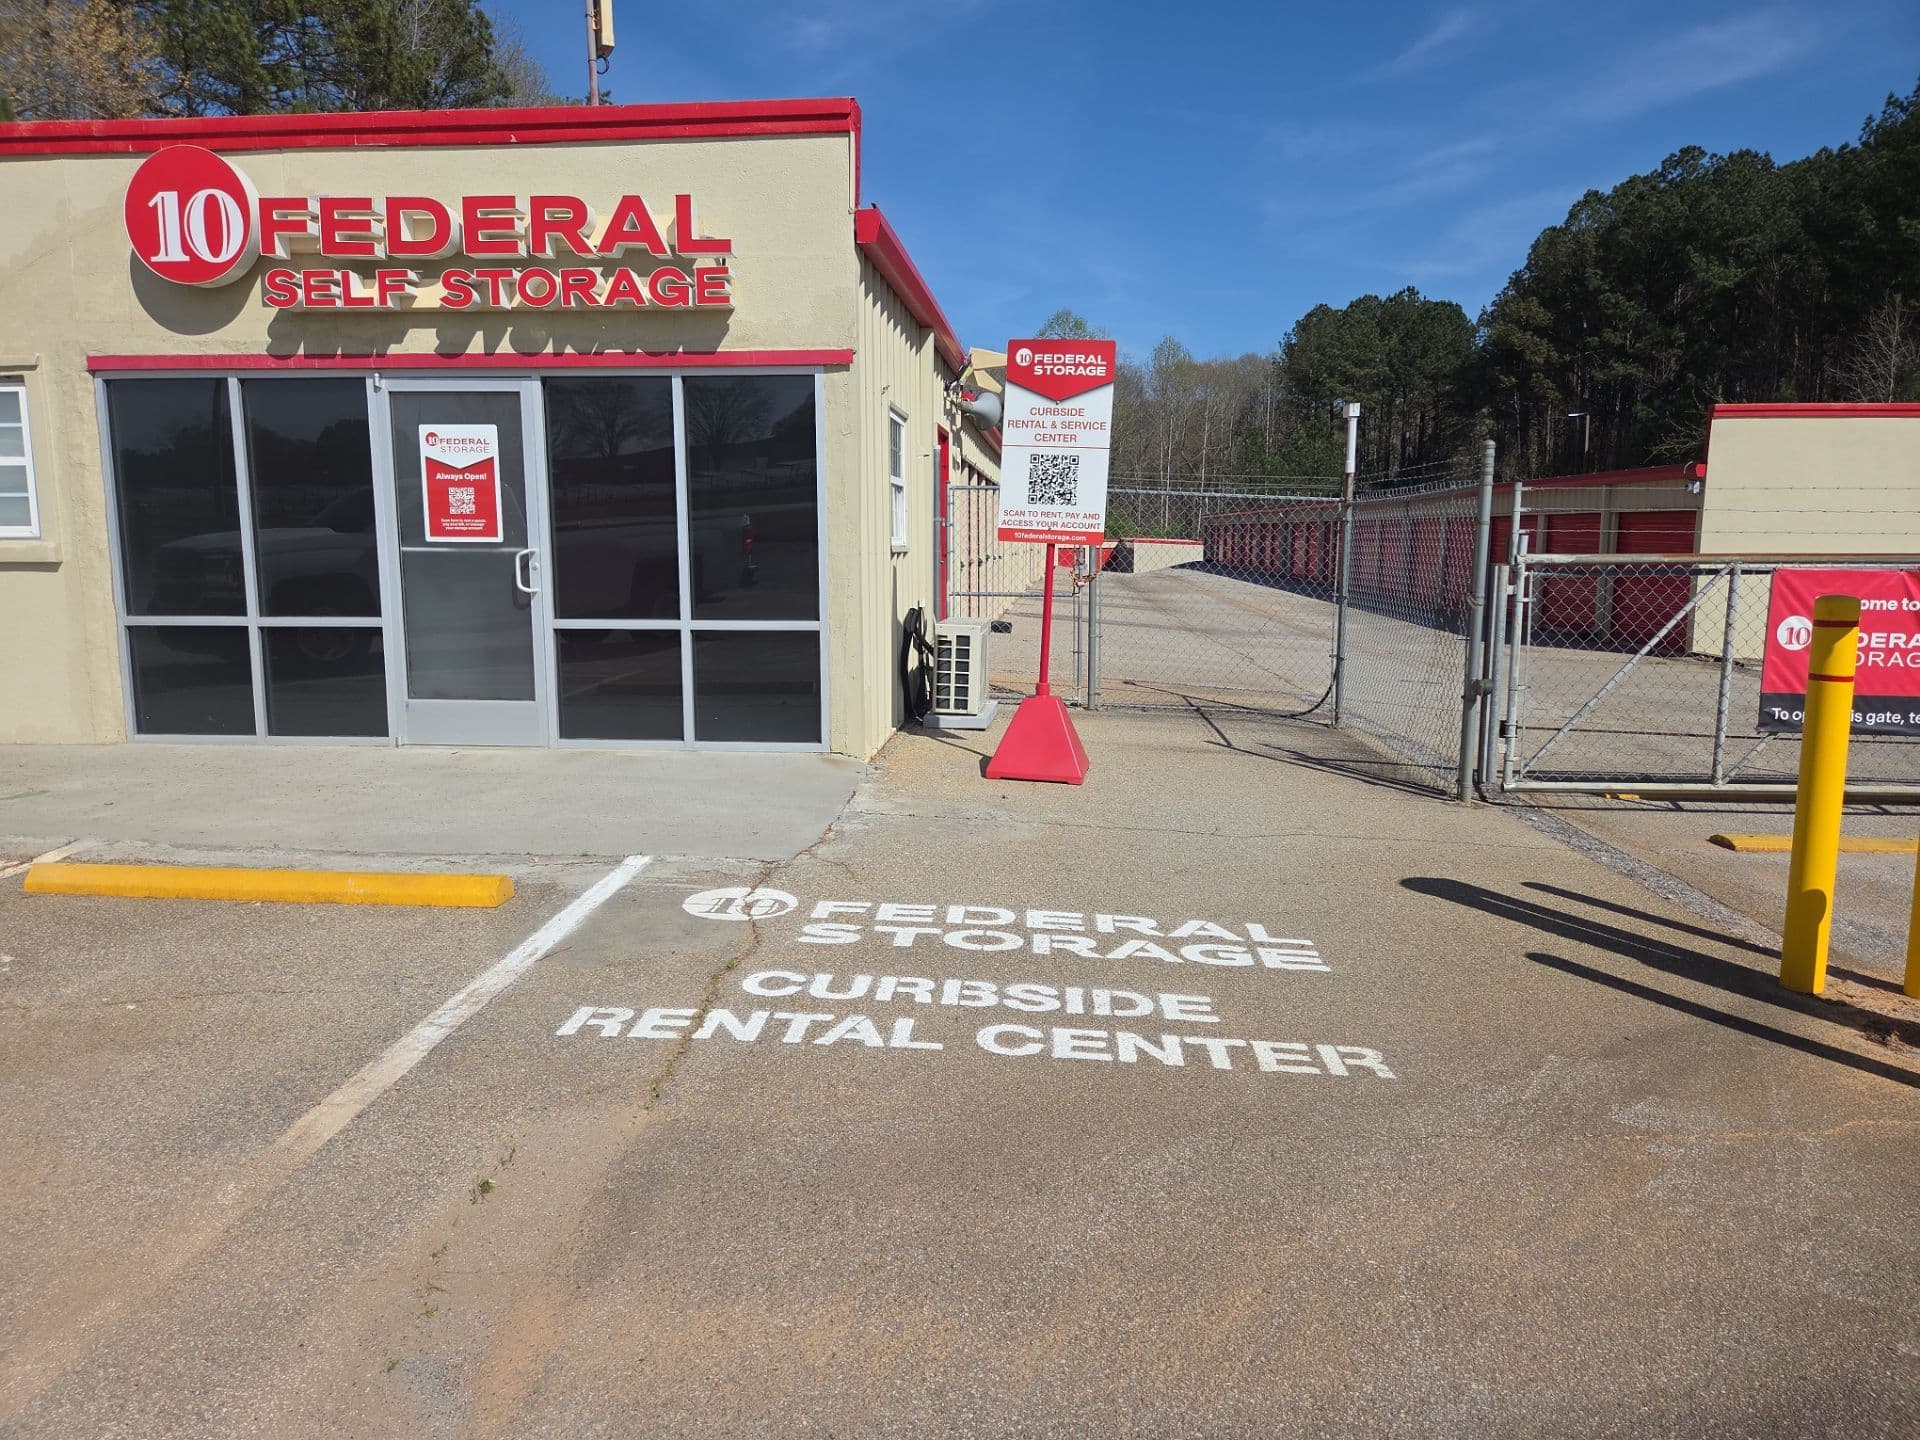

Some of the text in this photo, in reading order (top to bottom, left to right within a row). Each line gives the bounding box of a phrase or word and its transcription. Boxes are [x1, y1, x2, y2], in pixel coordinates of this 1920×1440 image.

[148, 188, 734, 264] 10 FEDERAL
[264, 266, 732, 309] SELF STORAGE
[1034, 353, 1107, 365] FEDERAL
[1033, 365, 1107, 377] STORAGE
[1029, 407, 1085, 417] CURBSIDE
[1007, 419, 1107, 431] RENTAL & SERVICE
[439, 438, 490, 446] FEDERAL
[1034, 433, 1077, 443] CENTER
[440, 445, 490, 454] STORAGE
[436, 472, 463, 481] Always
[1003, 509, 1026, 517] SCAN
[1028, 510, 1038, 518] TO
[1065, 512, 1080, 520] PAY
[1082, 513, 1100, 521] AND
[1001, 519, 1101, 530] ACCESS YOUR ACCOUNT
[1901, 597, 1920, 611] to
[1857, 632, 1920, 649] DERA
[1772, 707, 1789, 720] To
[1850, 709, 1863, 723] is
[1865, 711, 1904, 726] gate,
[810, 900, 1314, 946] FEDERAL
[798, 922, 1331, 973] STORAGE
[742, 970, 1221, 1023] CURBSIDE
[556, 1006, 1397, 1079] RENTAL CENTER
